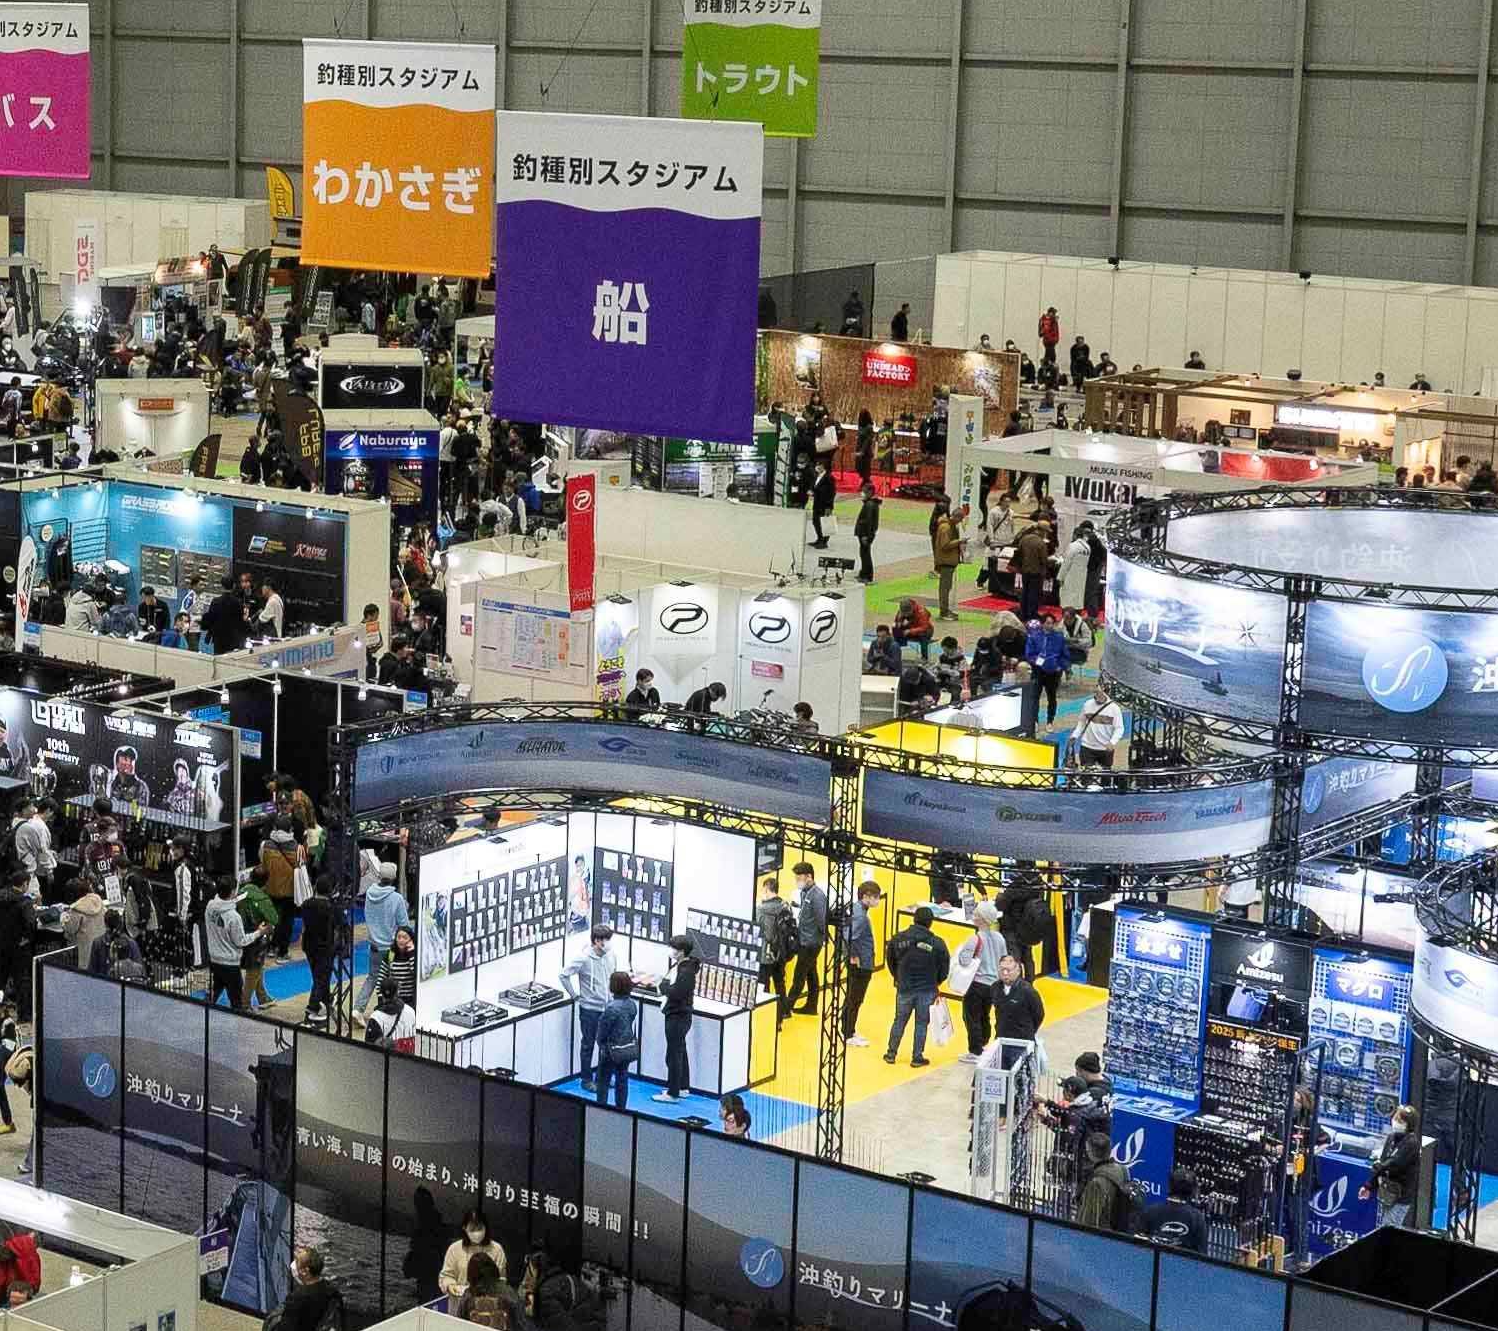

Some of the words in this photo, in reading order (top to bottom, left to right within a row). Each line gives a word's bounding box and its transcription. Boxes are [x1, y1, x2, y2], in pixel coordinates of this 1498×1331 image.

[317, 63, 480, 91] 釣種別スタジアム
[696, 63, 809, 95] トラウト
[313, 160, 482, 214] わかさぎ
[513, 154, 739, 193] 釣種別スタジアム
[591, 279, 650, 346] 船
[359, 434, 427, 450] Naburaya
[37, 748, 80, 766] Anniversary
[47, 737, 70, 753] 10th
[126, 1073, 246, 1126] 沖釣りマリーナ
[798, 1261, 956, 1327] 沖釣りマリーナ
